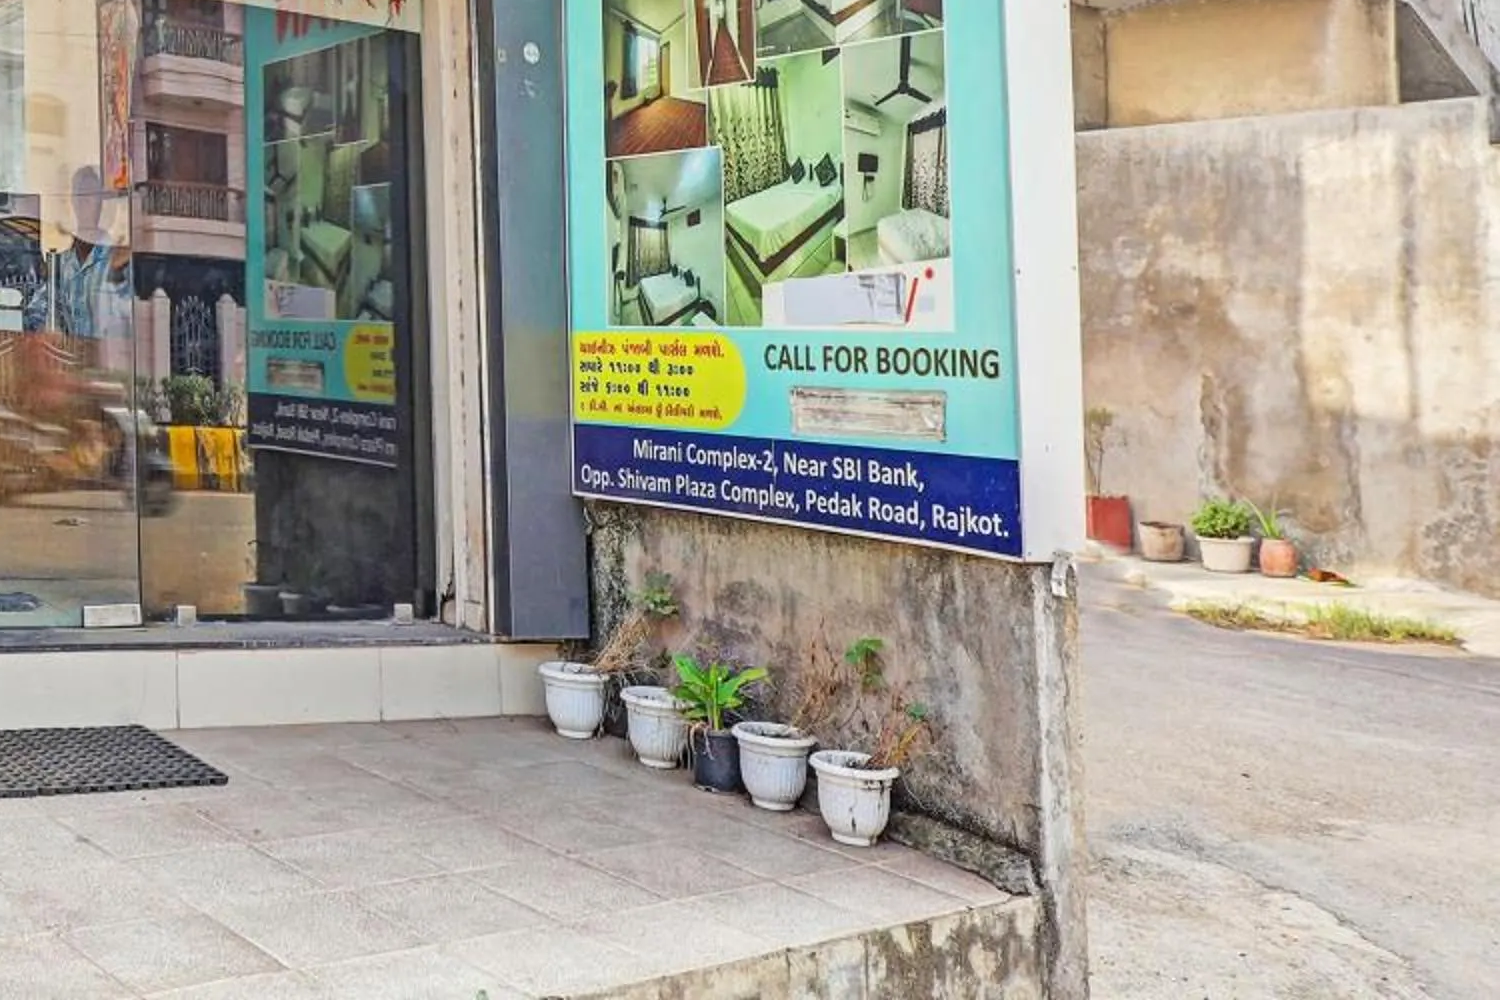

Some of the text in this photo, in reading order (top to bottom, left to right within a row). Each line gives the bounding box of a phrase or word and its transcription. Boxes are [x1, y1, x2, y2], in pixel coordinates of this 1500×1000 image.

[764, 344, 1000, 380] CALL FOR BOOKING
[633, 439, 925, 493] Mirani Complex-2, Near SBI Bank,
[581, 464, 1010, 538] Opp. Shivam Plaza Complex, Pedak Road, Rajkot.
